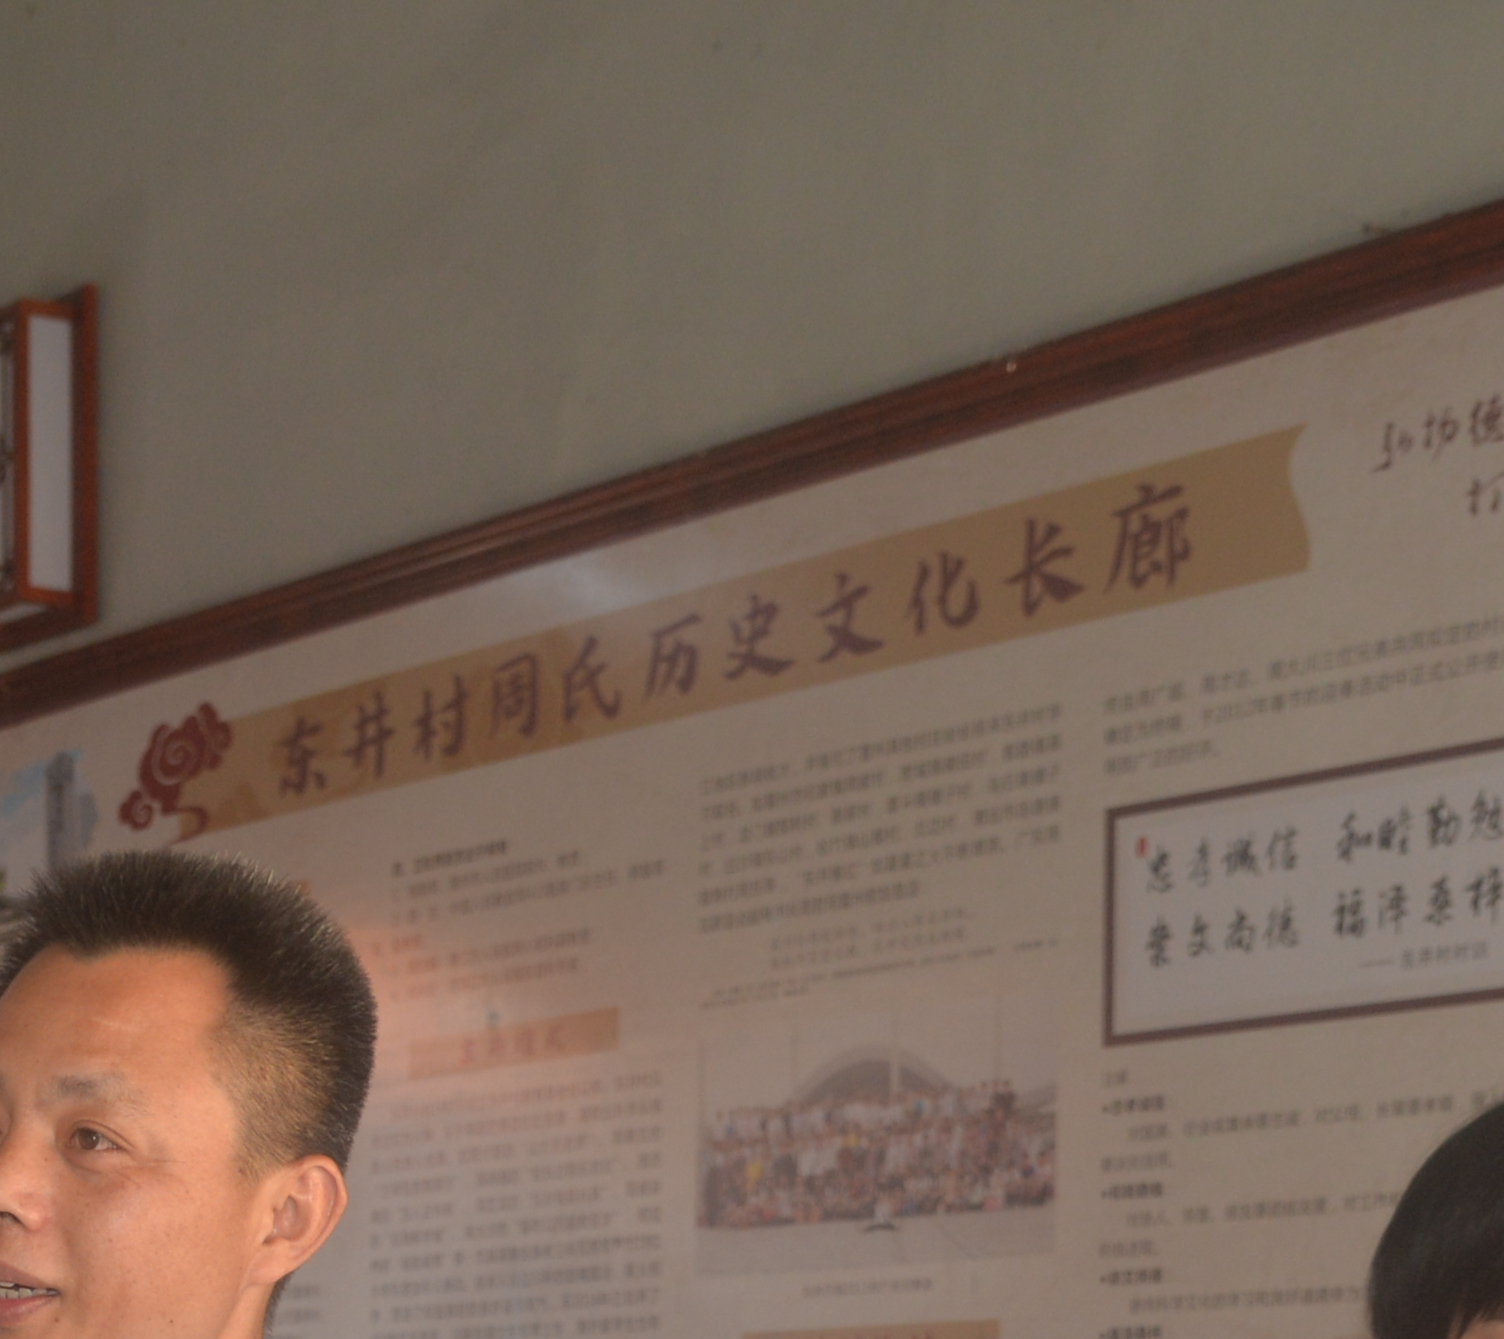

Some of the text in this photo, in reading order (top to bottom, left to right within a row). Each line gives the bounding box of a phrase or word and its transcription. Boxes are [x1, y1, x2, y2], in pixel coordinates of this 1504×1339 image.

[276, 480, 1194, 798] 东井村周氏历史文化长廊
[1145, 825, 1299, 894] 忠孝诚信
[1144, 900, 1299, 969] 崇文尚德
